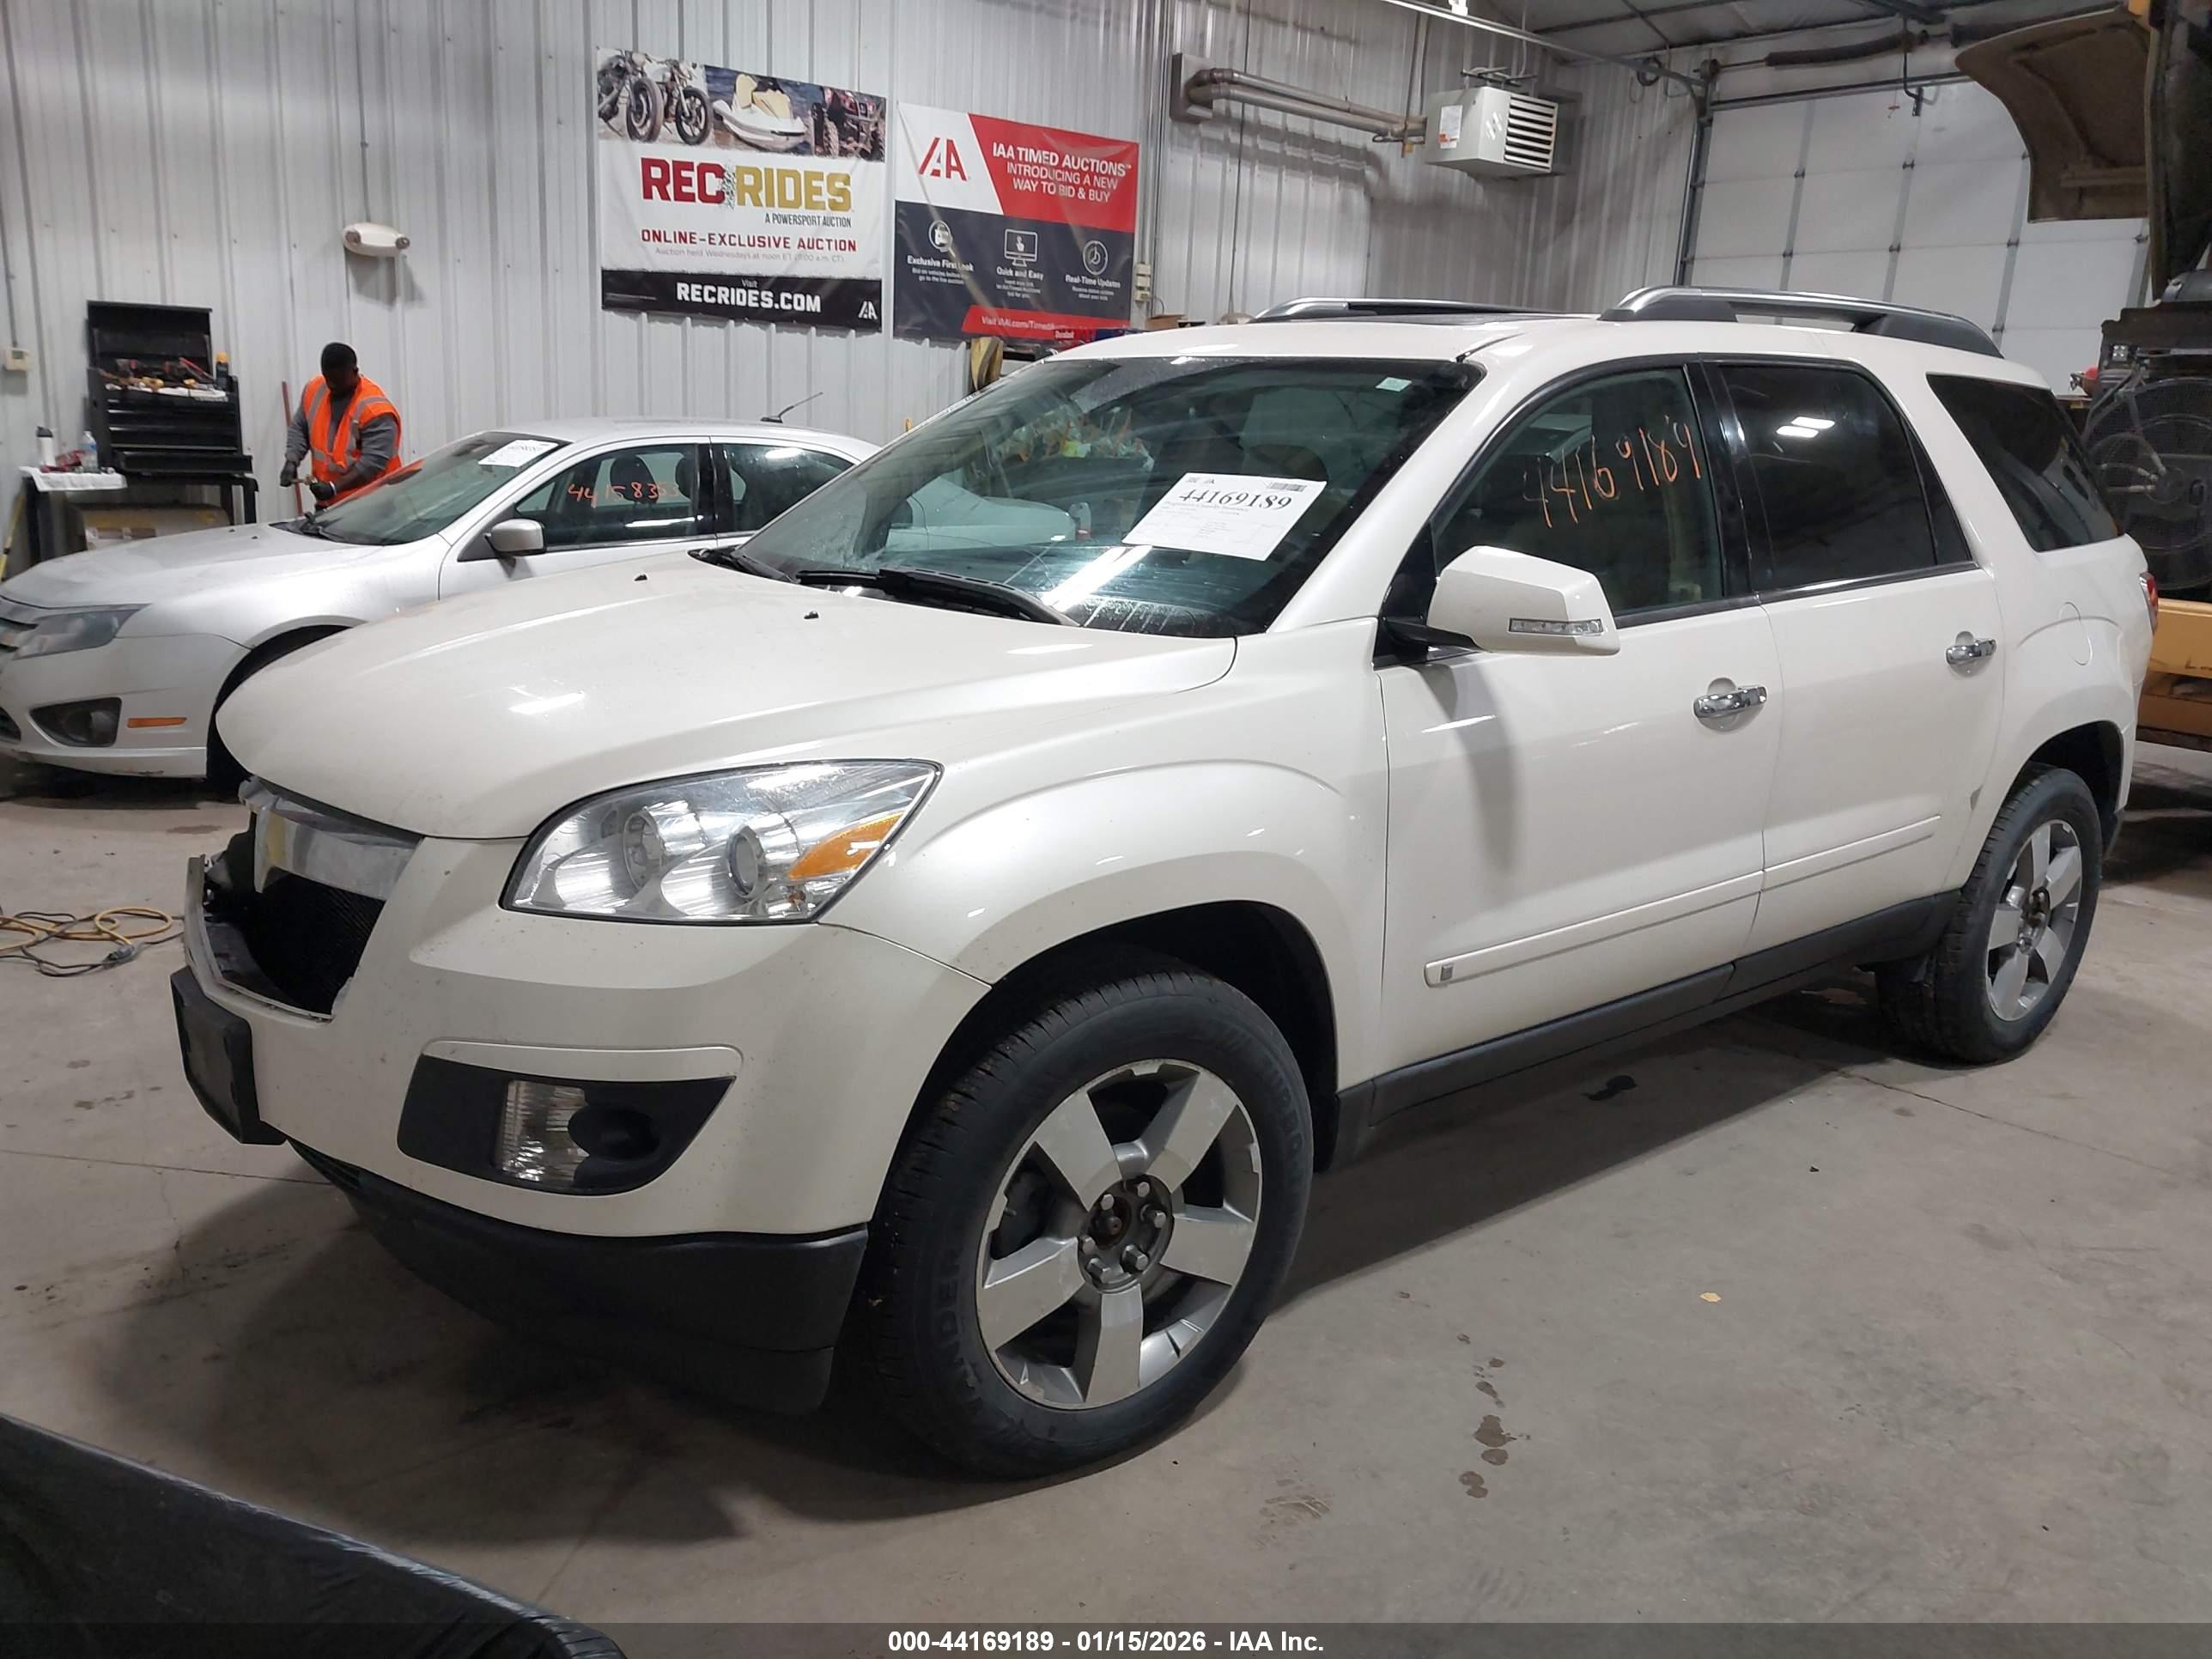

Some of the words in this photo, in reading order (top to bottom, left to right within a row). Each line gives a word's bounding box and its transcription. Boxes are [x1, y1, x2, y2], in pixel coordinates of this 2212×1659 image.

[993, 142, 1015, 160] IAA
[1016, 147, 1059, 167] TIMED
[641, 157, 726, 204] REC
[736, 165, 852, 212] RIDES
[1006, 161, 1082, 185] INTRODUCING
[1084, 173, 1091, 185] A
[1093, 173, 1118, 190] NEW
[1012, 178, 1038, 193] WAY
[1041, 180, 1056, 195] TO
[1058, 183, 1076, 198] BID
[1077, 186, 1086, 198] &
[1088, 186, 1111, 203] BUY
[765, 214, 770, 224] A
[772, 215, 822, 227] POWERSPORT
[823, 217, 852, 228] AUCTION
[641, 228, 791, 249] ONLINE-EXCLUSIVE
[797, 236, 857, 252] AUCTION
[907, 255, 941, 268] Exclusive
[741, 277, 758, 288] Visit
[996, 266, 1014, 276] Quick
[1015, 270, 1027, 278] and
[1028, 270, 1044, 282] Easy
[1065, 274, 1097, 286] Real-Time
[1097, 277, 1121, 289] Updates
[676, 281, 822, 314] RECRIDES.COM
[1179, 489, 1292, 510] 44169189
